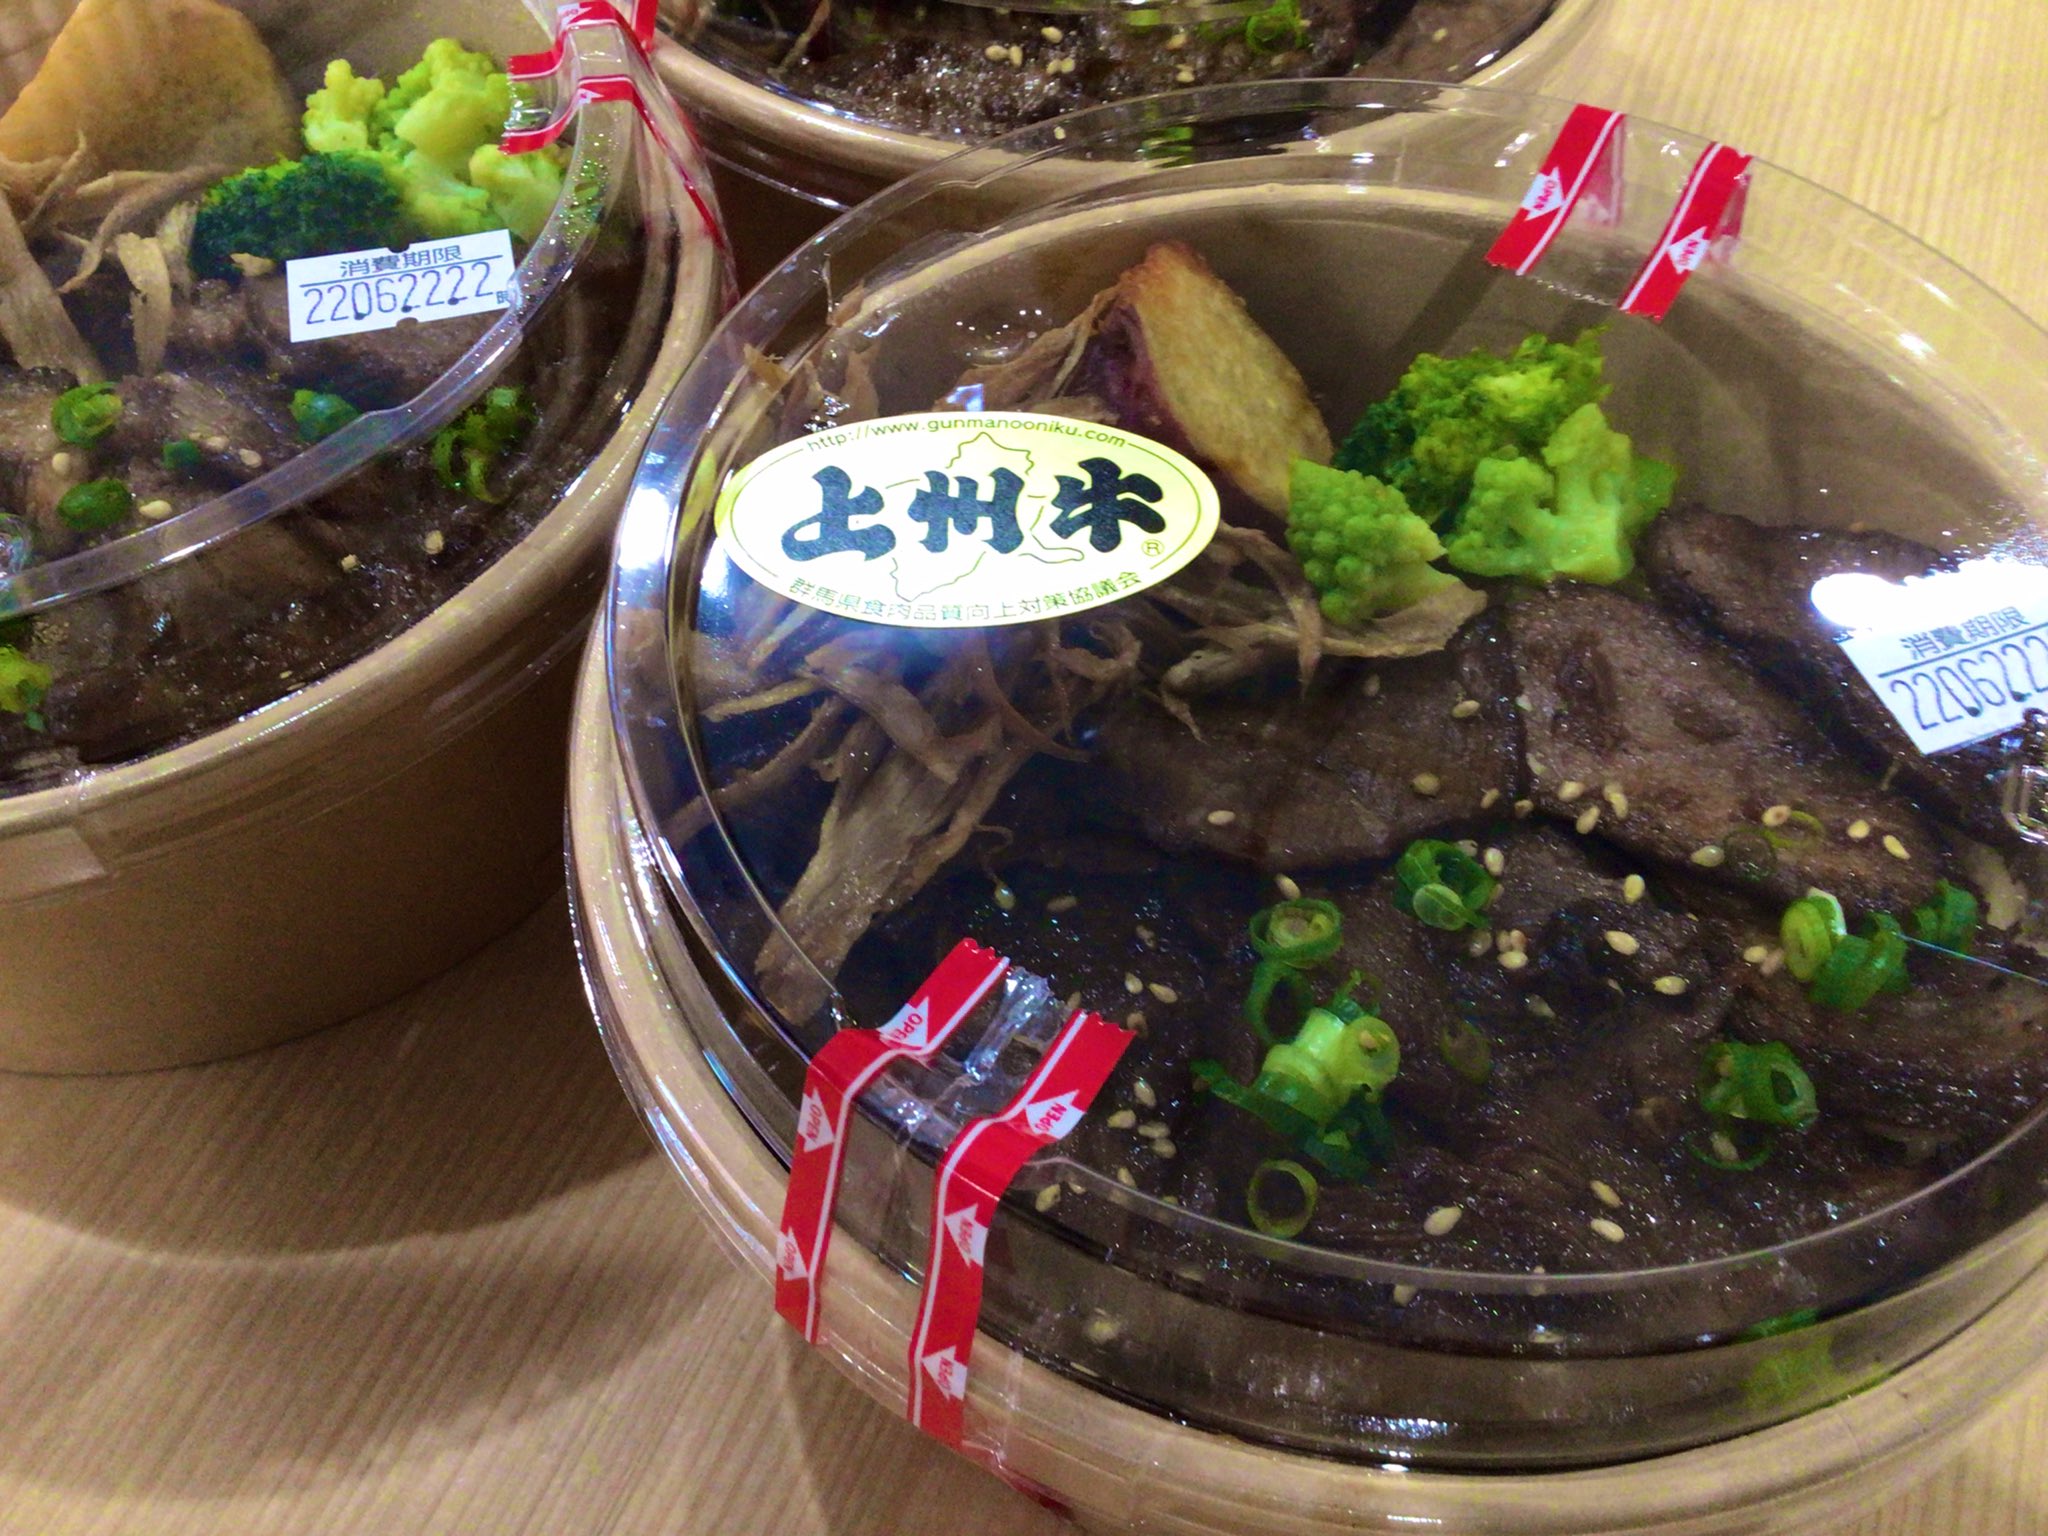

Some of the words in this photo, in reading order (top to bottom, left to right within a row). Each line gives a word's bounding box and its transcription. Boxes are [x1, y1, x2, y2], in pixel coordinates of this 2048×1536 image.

[339, 245, 463, 278] 消費期限
[807, 417, 1127, 452] http://www.gunmanooniku.com
[780, 456, 1167, 563] 上州牛
[1900, 606, 2031, 660] 消費期限
[1034, 1102, 1067, 1131] OPEN
